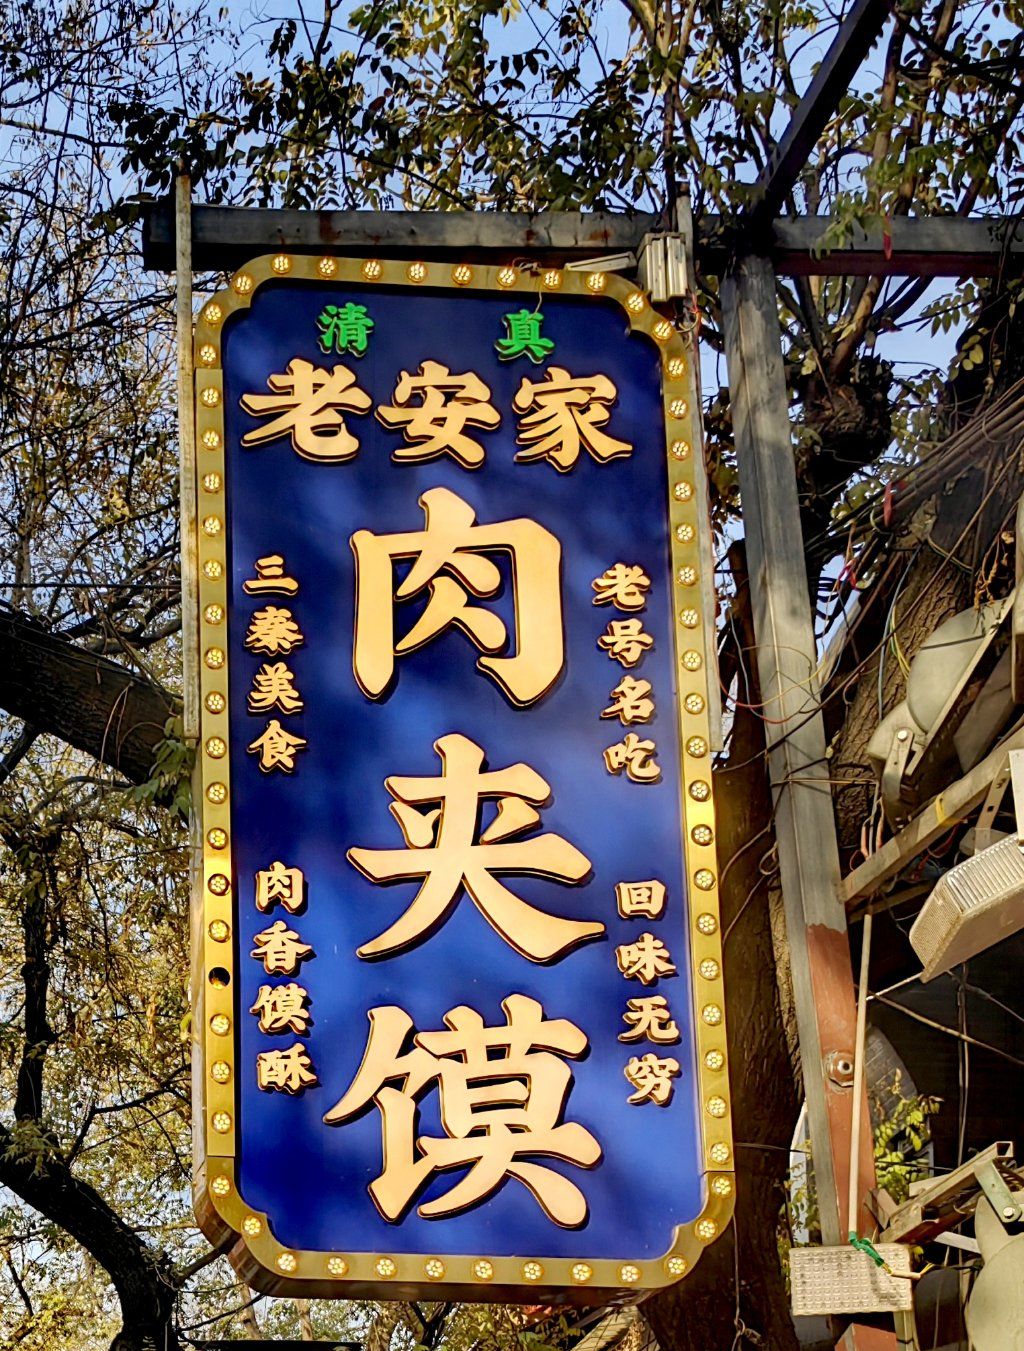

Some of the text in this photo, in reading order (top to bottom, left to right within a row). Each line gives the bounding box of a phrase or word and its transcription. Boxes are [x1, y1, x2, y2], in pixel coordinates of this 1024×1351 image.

[239, 358, 632, 472] 老安家
[242, 554, 307, 773] 三秦美食
[590, 561, 662, 783] 老号名吃
[323, 487, 607, 1228] 肉夹馍
[251, 861, 318, 1094] 肉香馍酥
[615, 879, 681, 1105] 回味无穷
